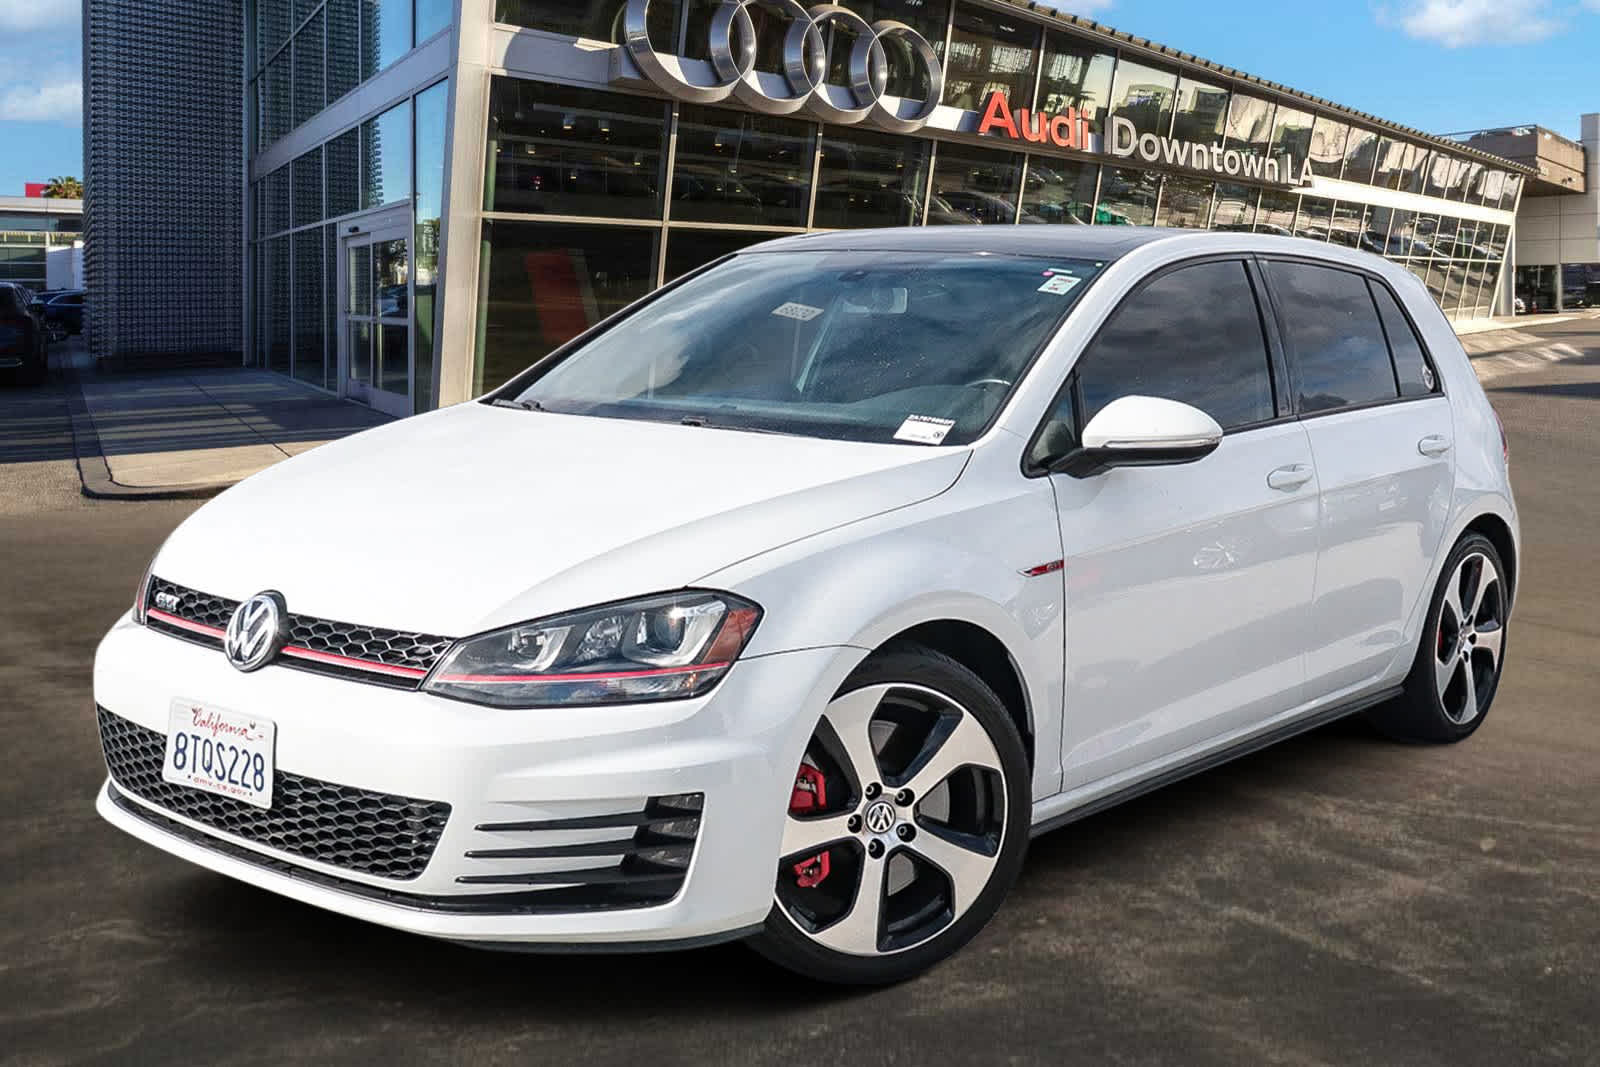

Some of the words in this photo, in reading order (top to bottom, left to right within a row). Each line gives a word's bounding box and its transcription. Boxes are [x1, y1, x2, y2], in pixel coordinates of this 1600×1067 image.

[978, 91, 1089, 150] Audi
[1106, 116, 1279, 183] Downtown
[1286, 153, 1316, 188] LA
[192, 707, 254, 741] California
[173, 731, 265, 792] 8TQS228
